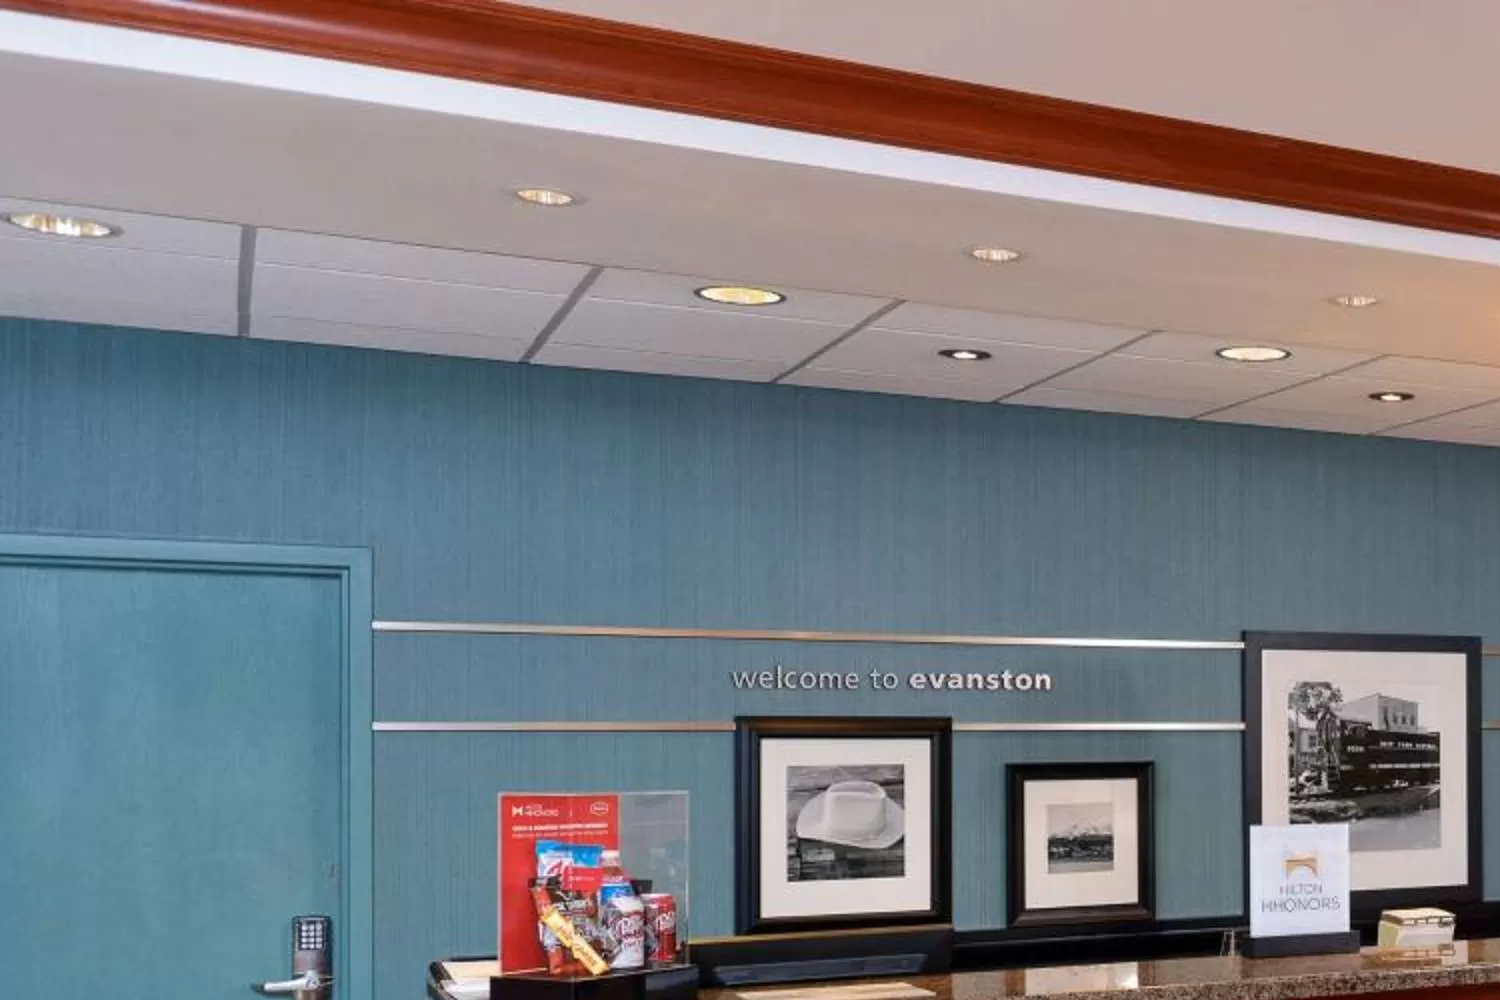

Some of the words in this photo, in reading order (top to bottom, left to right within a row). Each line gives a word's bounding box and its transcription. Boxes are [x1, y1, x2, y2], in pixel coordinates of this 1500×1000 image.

[731, 665, 860, 690] welcome
[870, 670, 898, 690] to
[909, 668, 1051, 690] evanston
[1261, 896, 1341, 912] HHONORS
